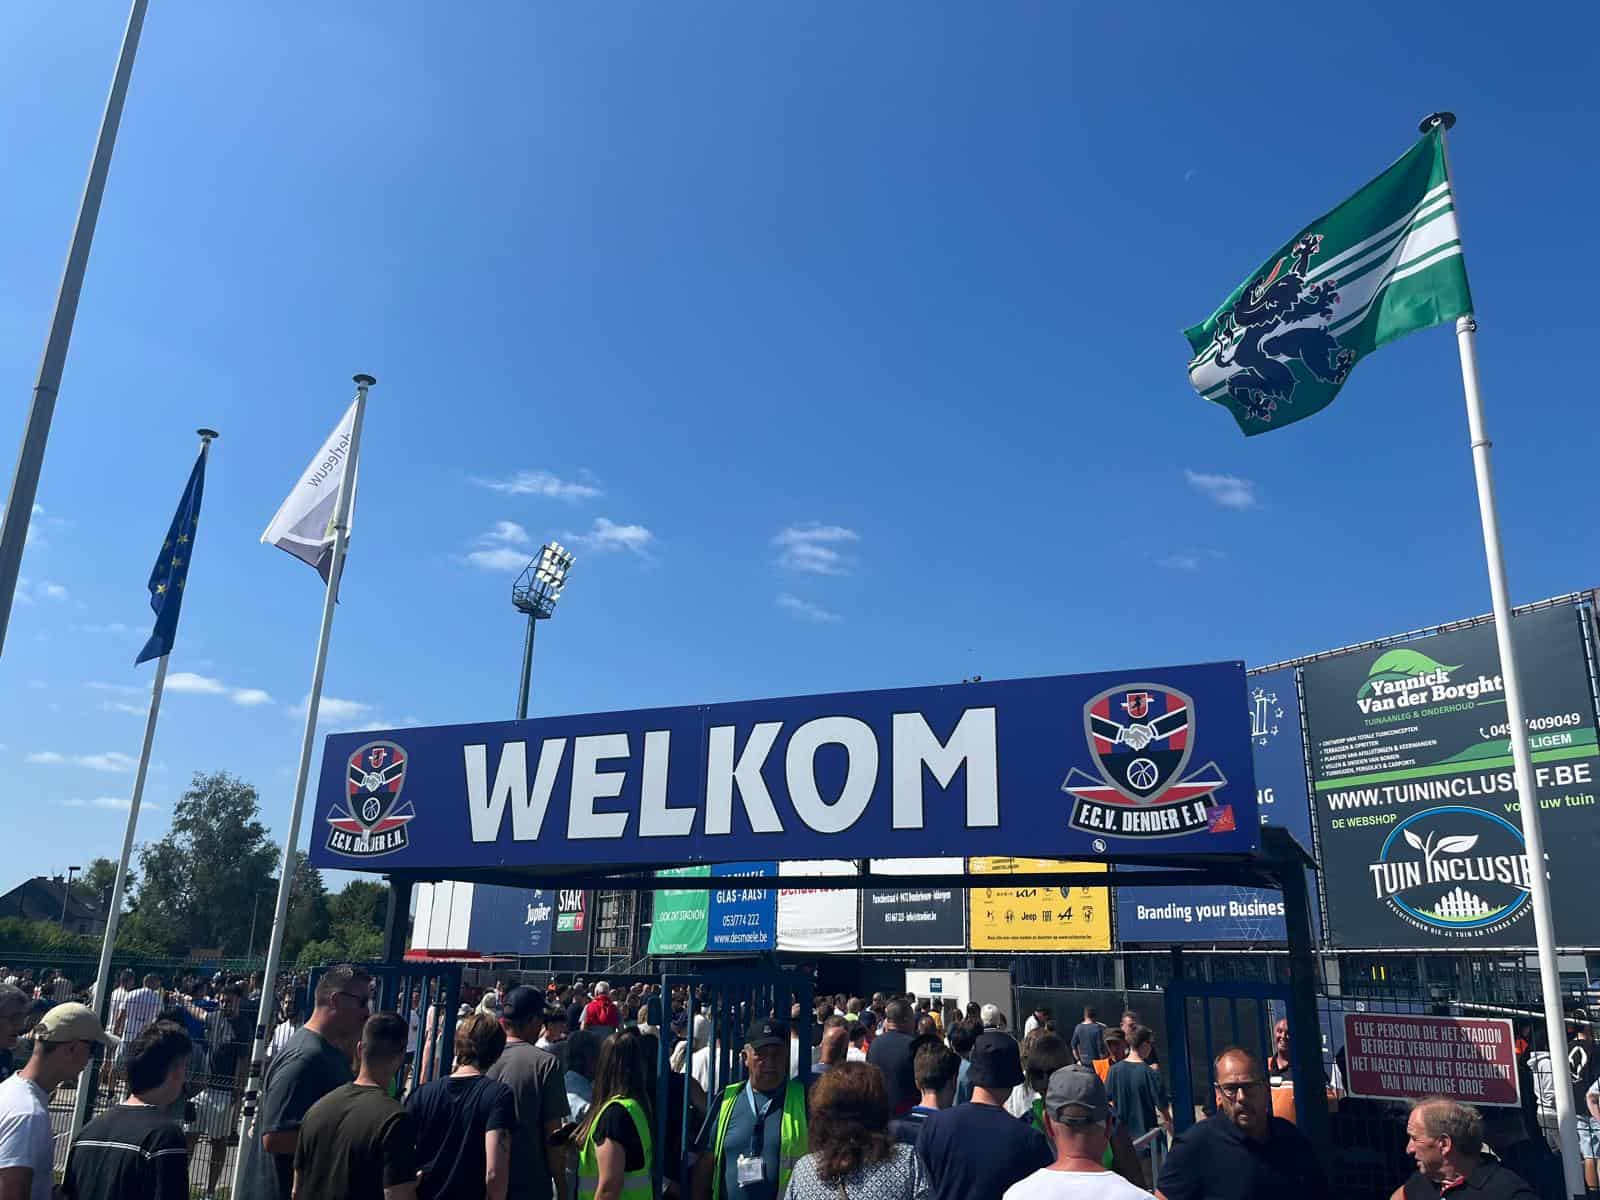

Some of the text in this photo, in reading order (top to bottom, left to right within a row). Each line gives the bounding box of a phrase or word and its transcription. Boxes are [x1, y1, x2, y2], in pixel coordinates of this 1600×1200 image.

[1371, 667, 1450, 697] Yannick
[1357, 698, 1395, 714] Van
[1397, 690, 1428, 708] der
[1364, 702, 1475, 727] TUINAANLEG & ONDERHOUD
[1508, 733, 1572, 752] LIGEM
[463, 707, 999, 843] WELKOM
[1327, 763, 1592, 811] WWW.TUININCLUSIF.BE
[1540, 798, 1561, 809] uw
[1565, 793, 1595, 807] tuin
[1079, 803, 1117, 831] F.C.V.
[1122, 806, 1181, 833] DENDER
[1332, 814, 1397, 829] DE WEBSHOP
[331, 831, 352, 852] F.C.V.
[1369, 861, 1422, 900] TUIN
[1021, 911, 1037, 922] Jeep
[1137, 903, 1192, 923] Branding
[1196, 904, 1226, 922] your
[714, 931, 768, 945] www.desmaele.be
[1355, 1021, 1502, 1043] ELKE PERSOON DIE HET STADION
[1456, 1043, 1477, 1059] ZICH
[1479, 1044, 1497, 1061] TOT
[1352, 1056, 1511, 1080] HET NALEVEN VAN HET REGLEMENT
[1381, 1075, 1485, 1096] VAN INWENDIGE ORDE
